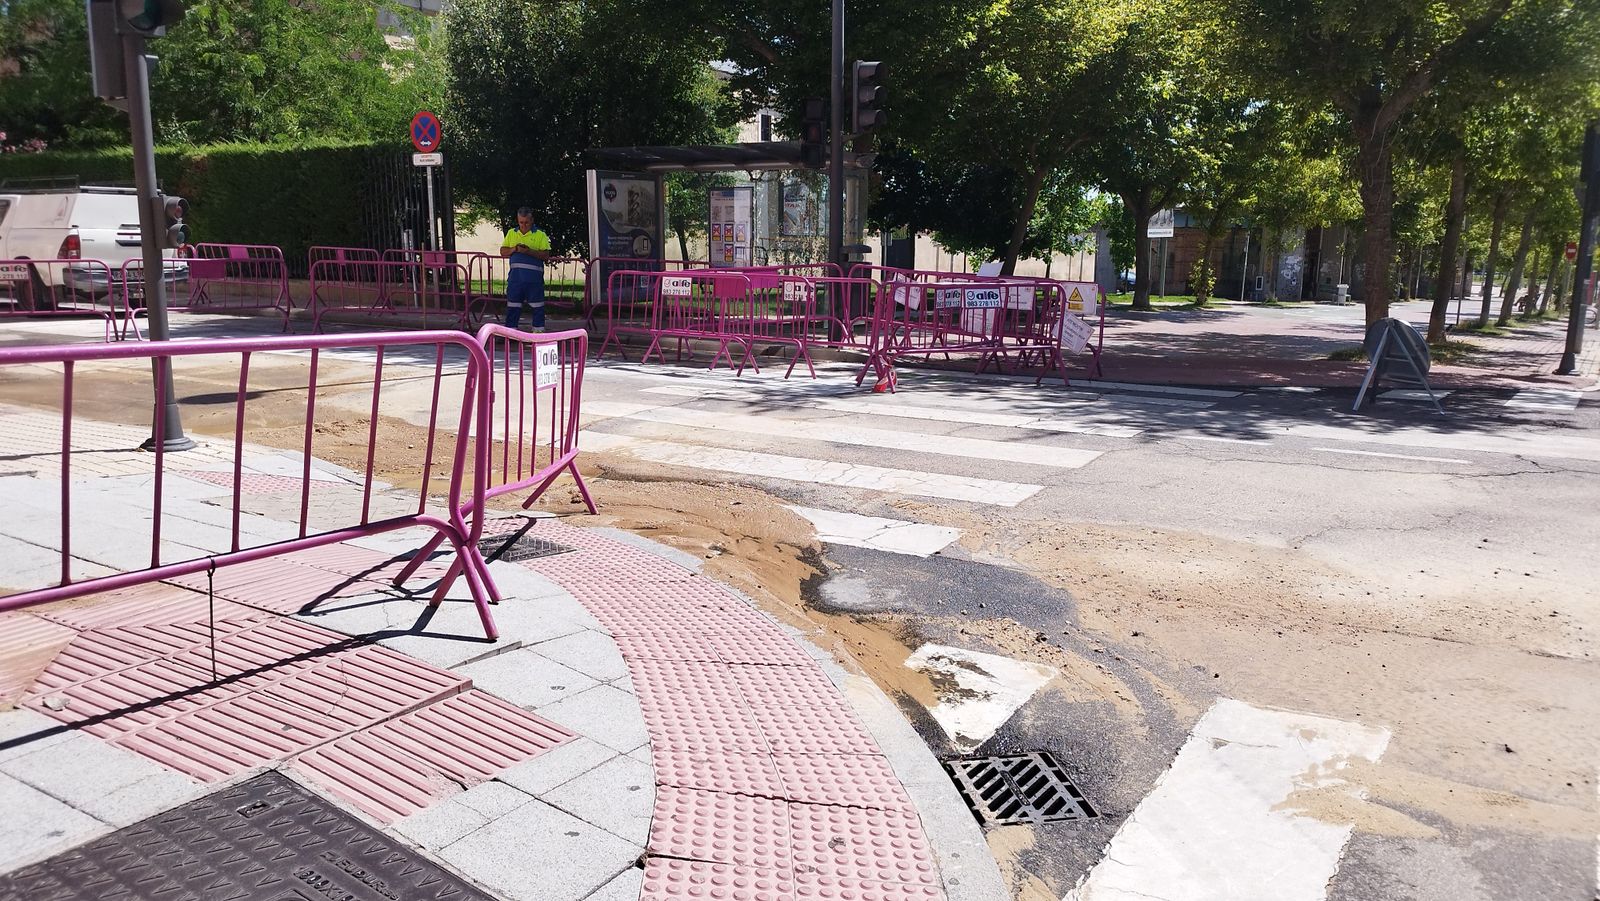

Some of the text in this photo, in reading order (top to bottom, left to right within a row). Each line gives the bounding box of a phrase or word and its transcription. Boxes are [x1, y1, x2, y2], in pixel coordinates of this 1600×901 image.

[672, 279, 691, 288] alfe
[976, 291, 999, 300] alfe
[542, 349, 558, 366] alfe
